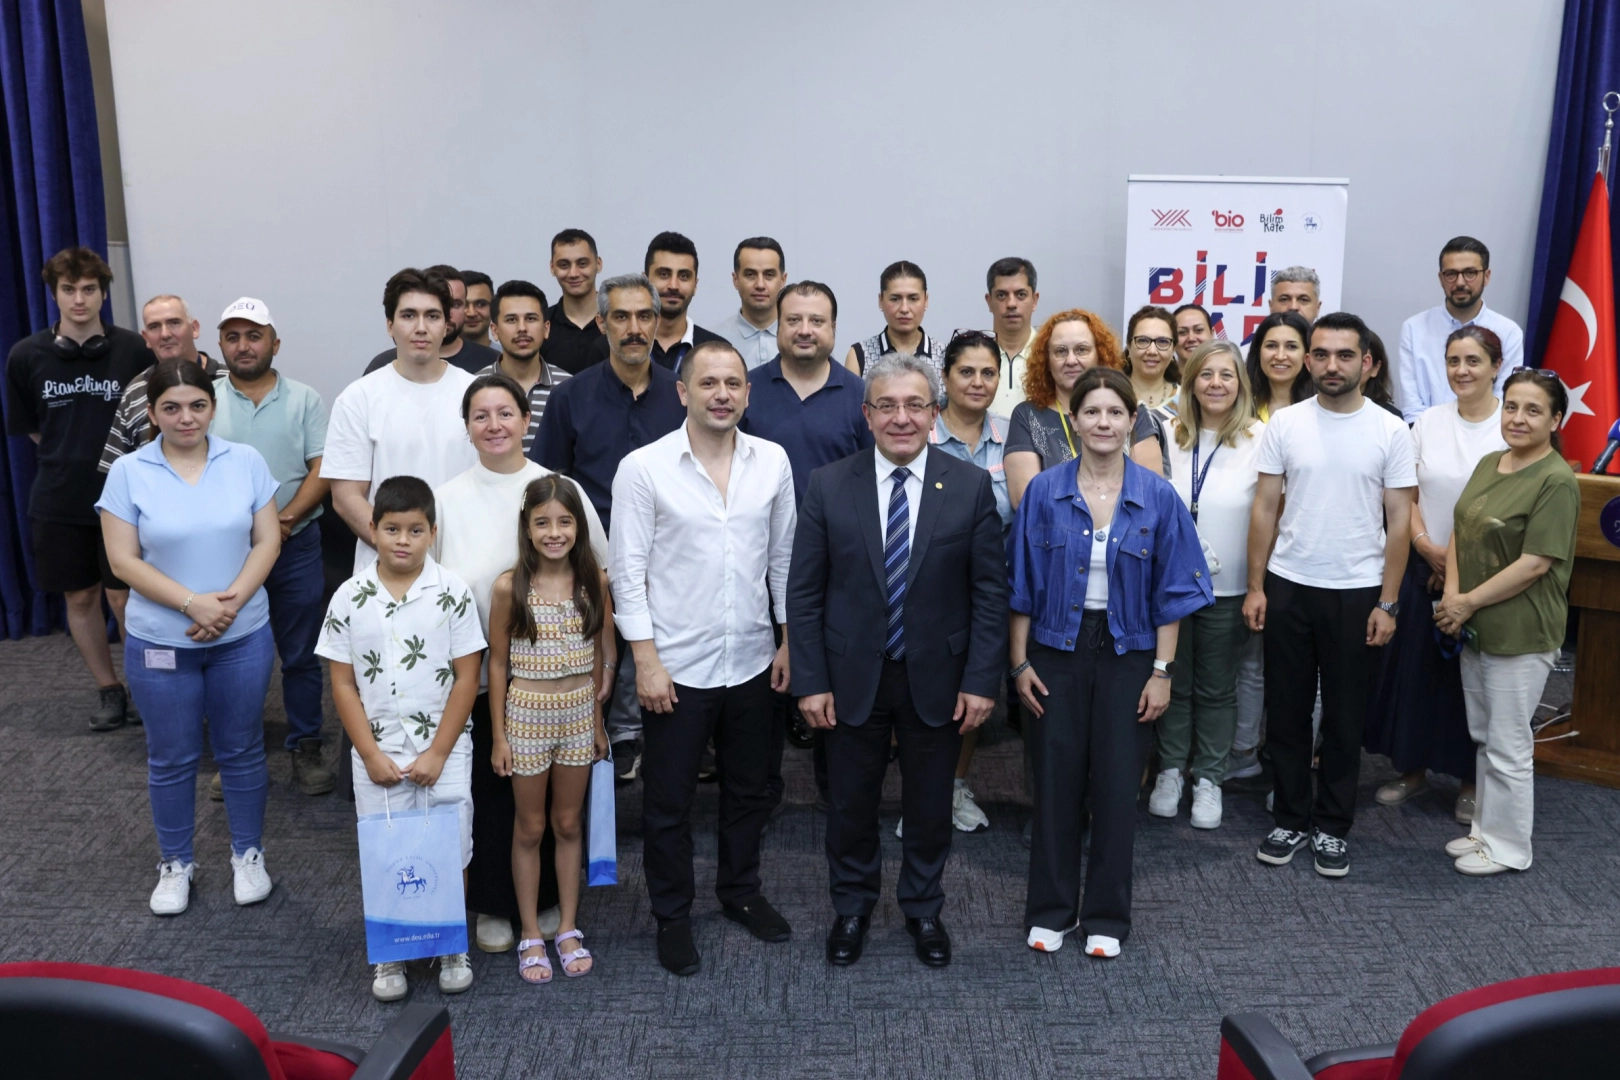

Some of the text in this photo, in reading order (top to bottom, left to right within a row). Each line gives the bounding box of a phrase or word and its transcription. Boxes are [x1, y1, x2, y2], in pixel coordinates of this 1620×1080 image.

[1259, 212, 1284, 224] Bilim
[1263, 222, 1285, 233] Kafe
[1148, 250, 1316, 307] BİLİ
[393, 932, 441, 944] www.deu.edu.tr
